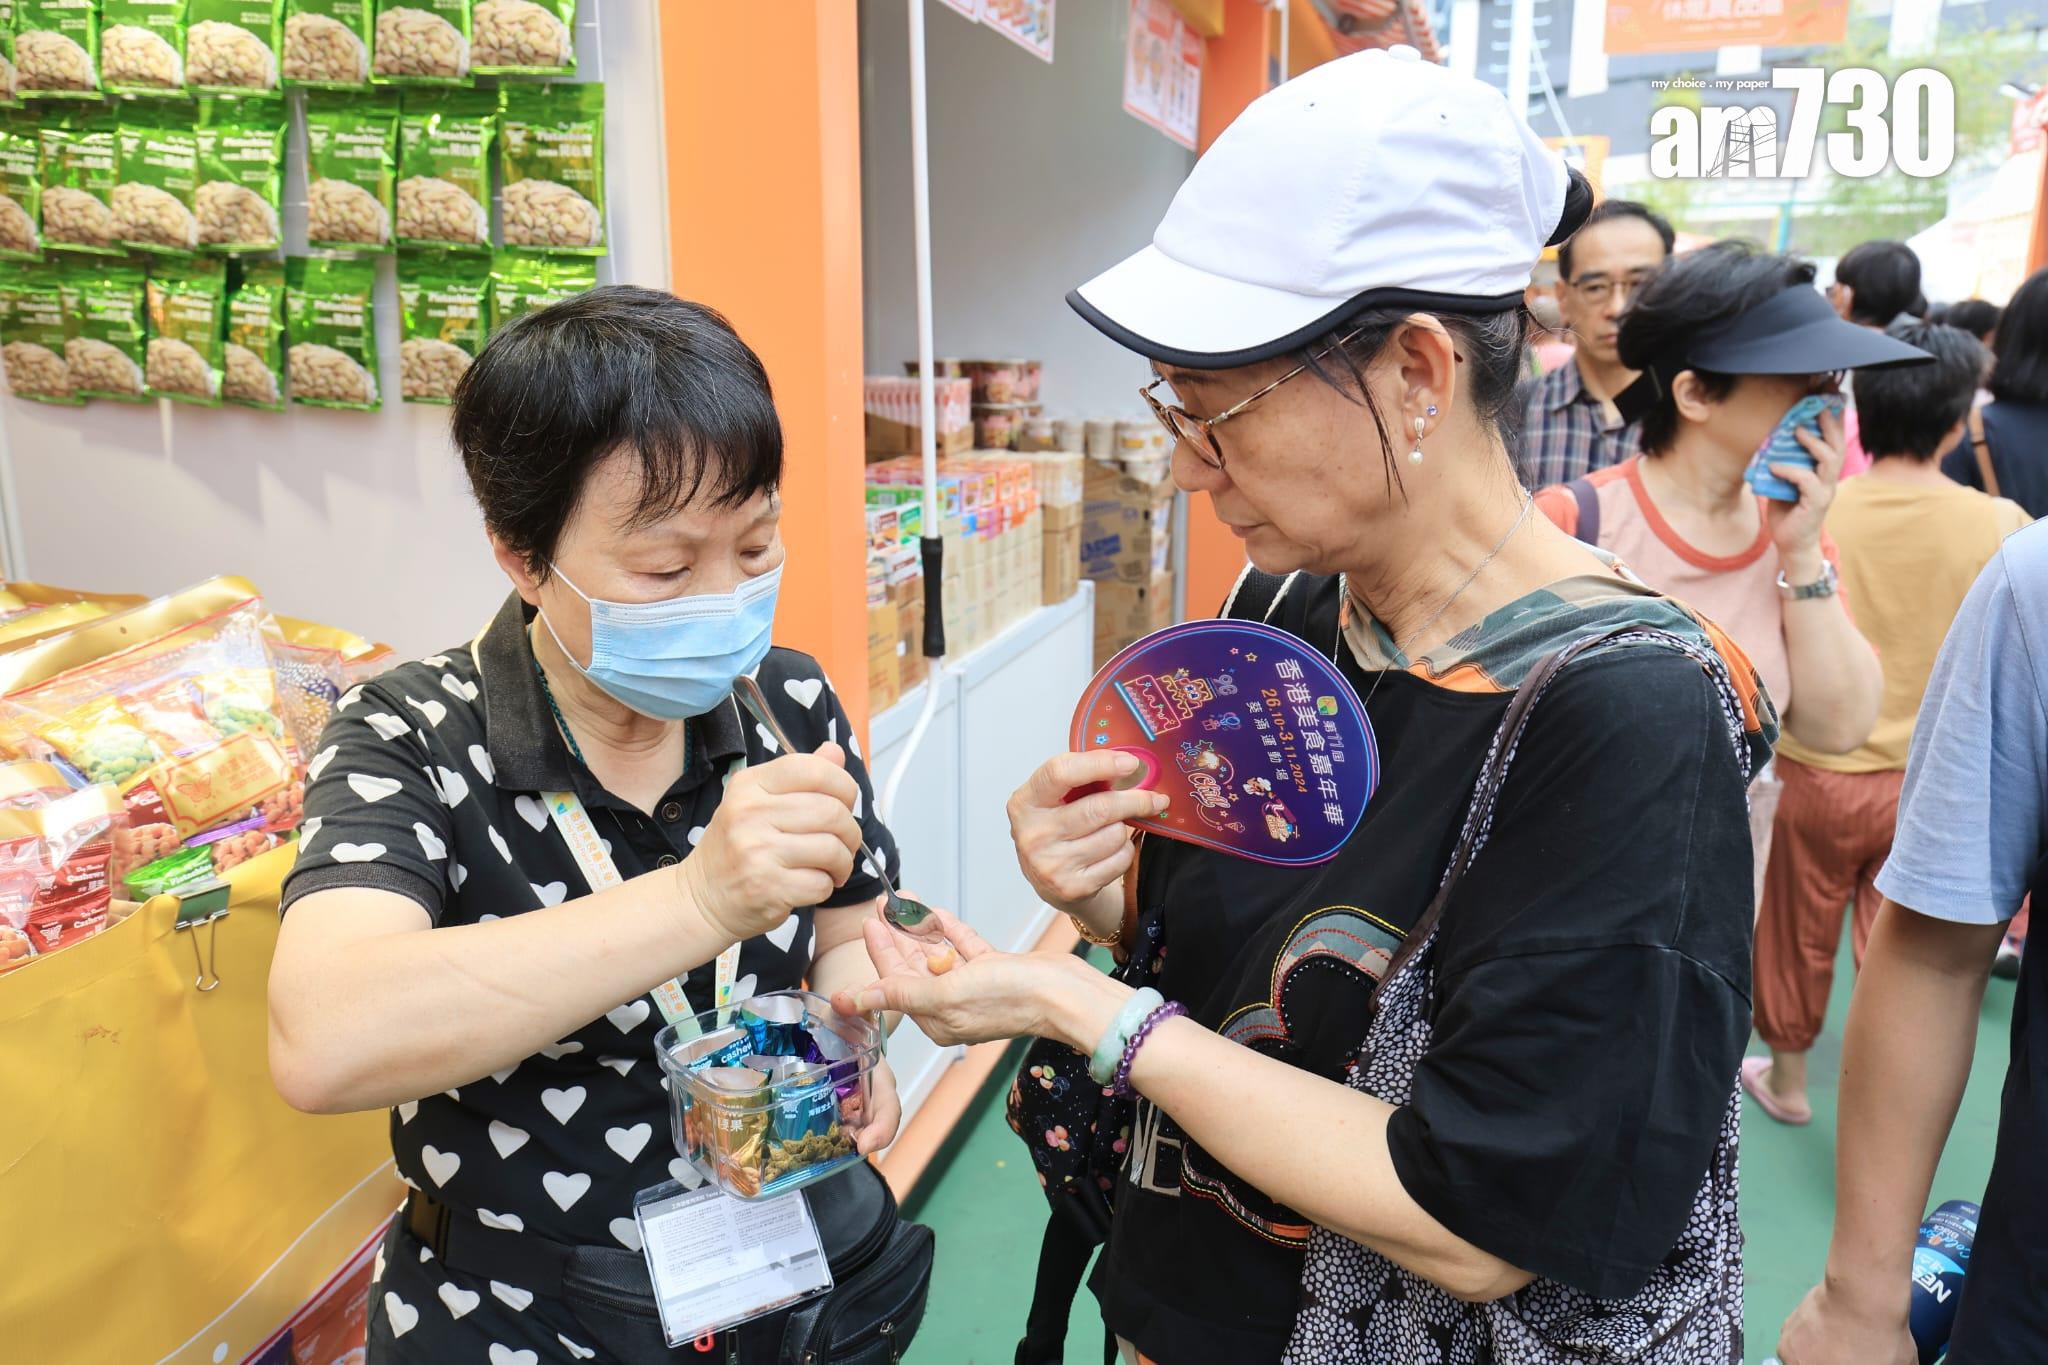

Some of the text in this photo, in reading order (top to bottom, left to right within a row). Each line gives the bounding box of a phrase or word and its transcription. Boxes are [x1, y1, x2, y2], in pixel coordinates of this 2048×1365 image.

[1246, 700, 1290, 781] 葵涌運動場
[1261, 688, 1308, 793] 26.10-3.11.2024
[1275, 658, 1344, 827] 香港美食嘉年華
